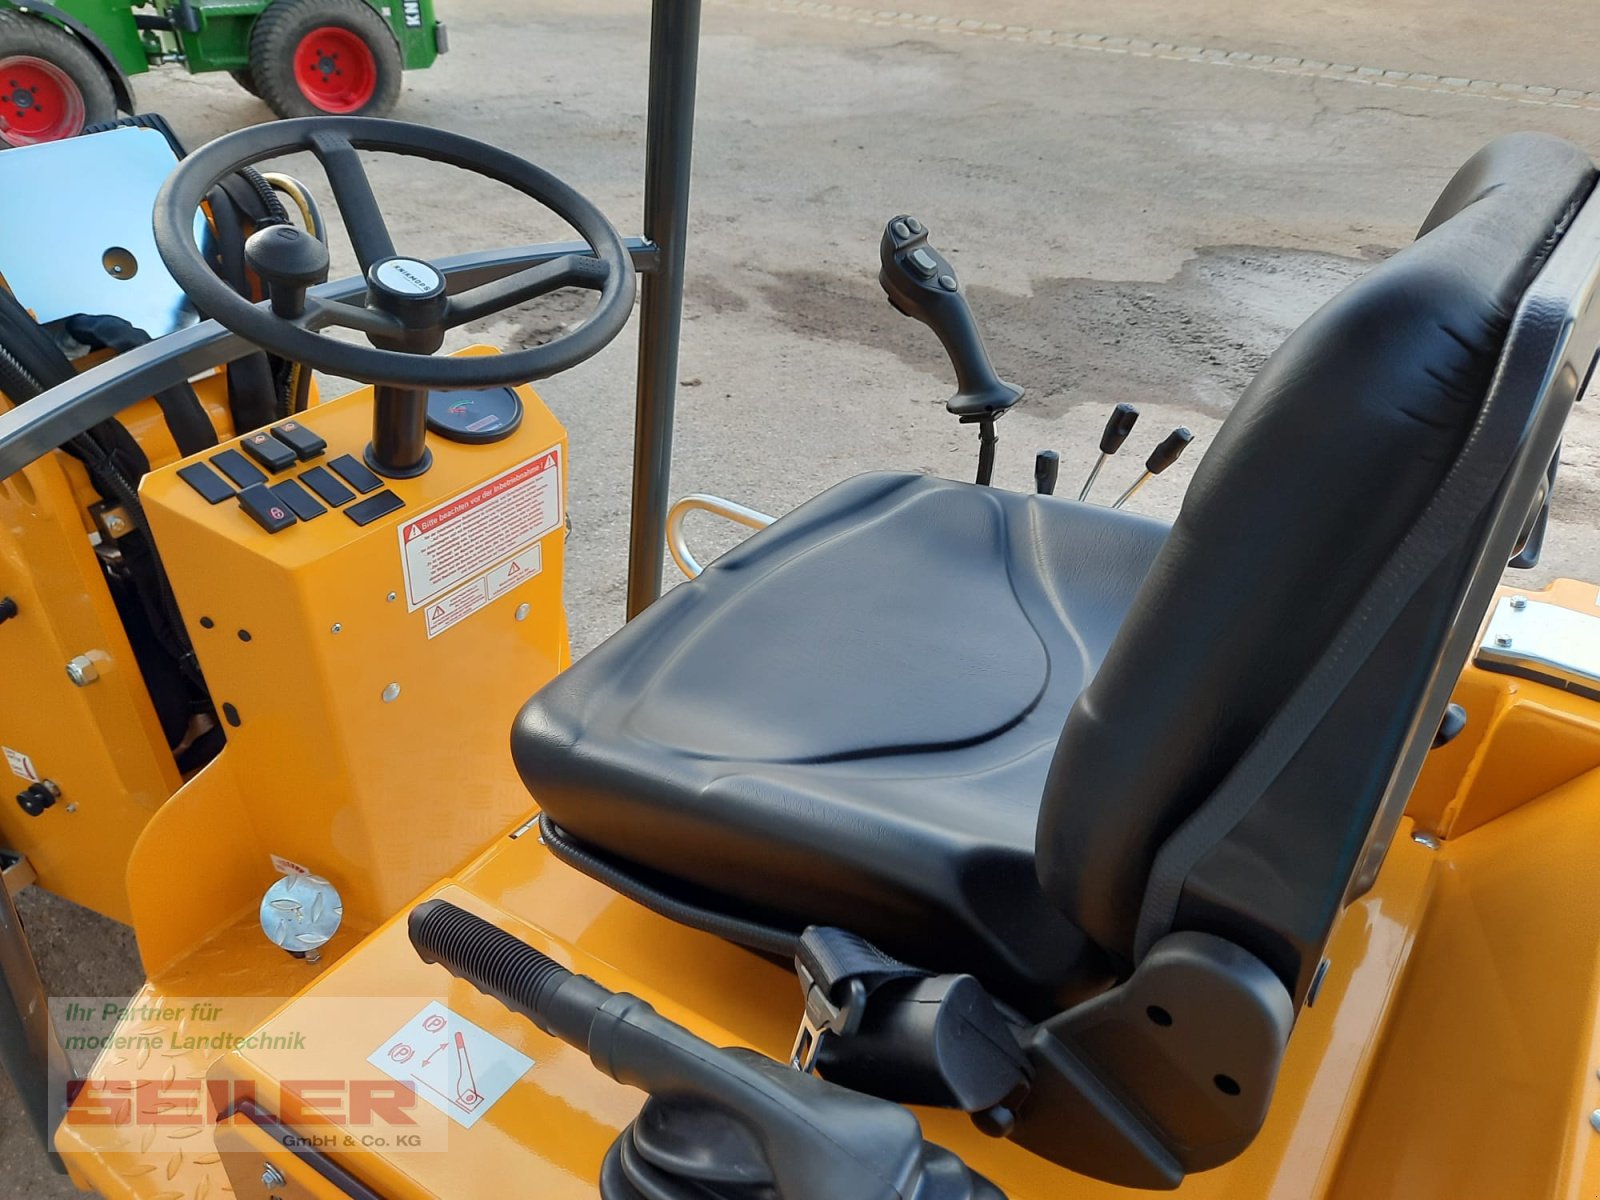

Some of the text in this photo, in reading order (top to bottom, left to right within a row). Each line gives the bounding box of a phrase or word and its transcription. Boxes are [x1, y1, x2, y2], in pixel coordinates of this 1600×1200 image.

[393, 265, 431, 291] KNIKMOPS
[421, 517, 438, 531] Bitte
[439, 501, 469, 521] beachten
[470, 496, 482, 505] vor
[482, 488, 493, 499] der
[493, 464, 540, 494] Inbetriebnahme
